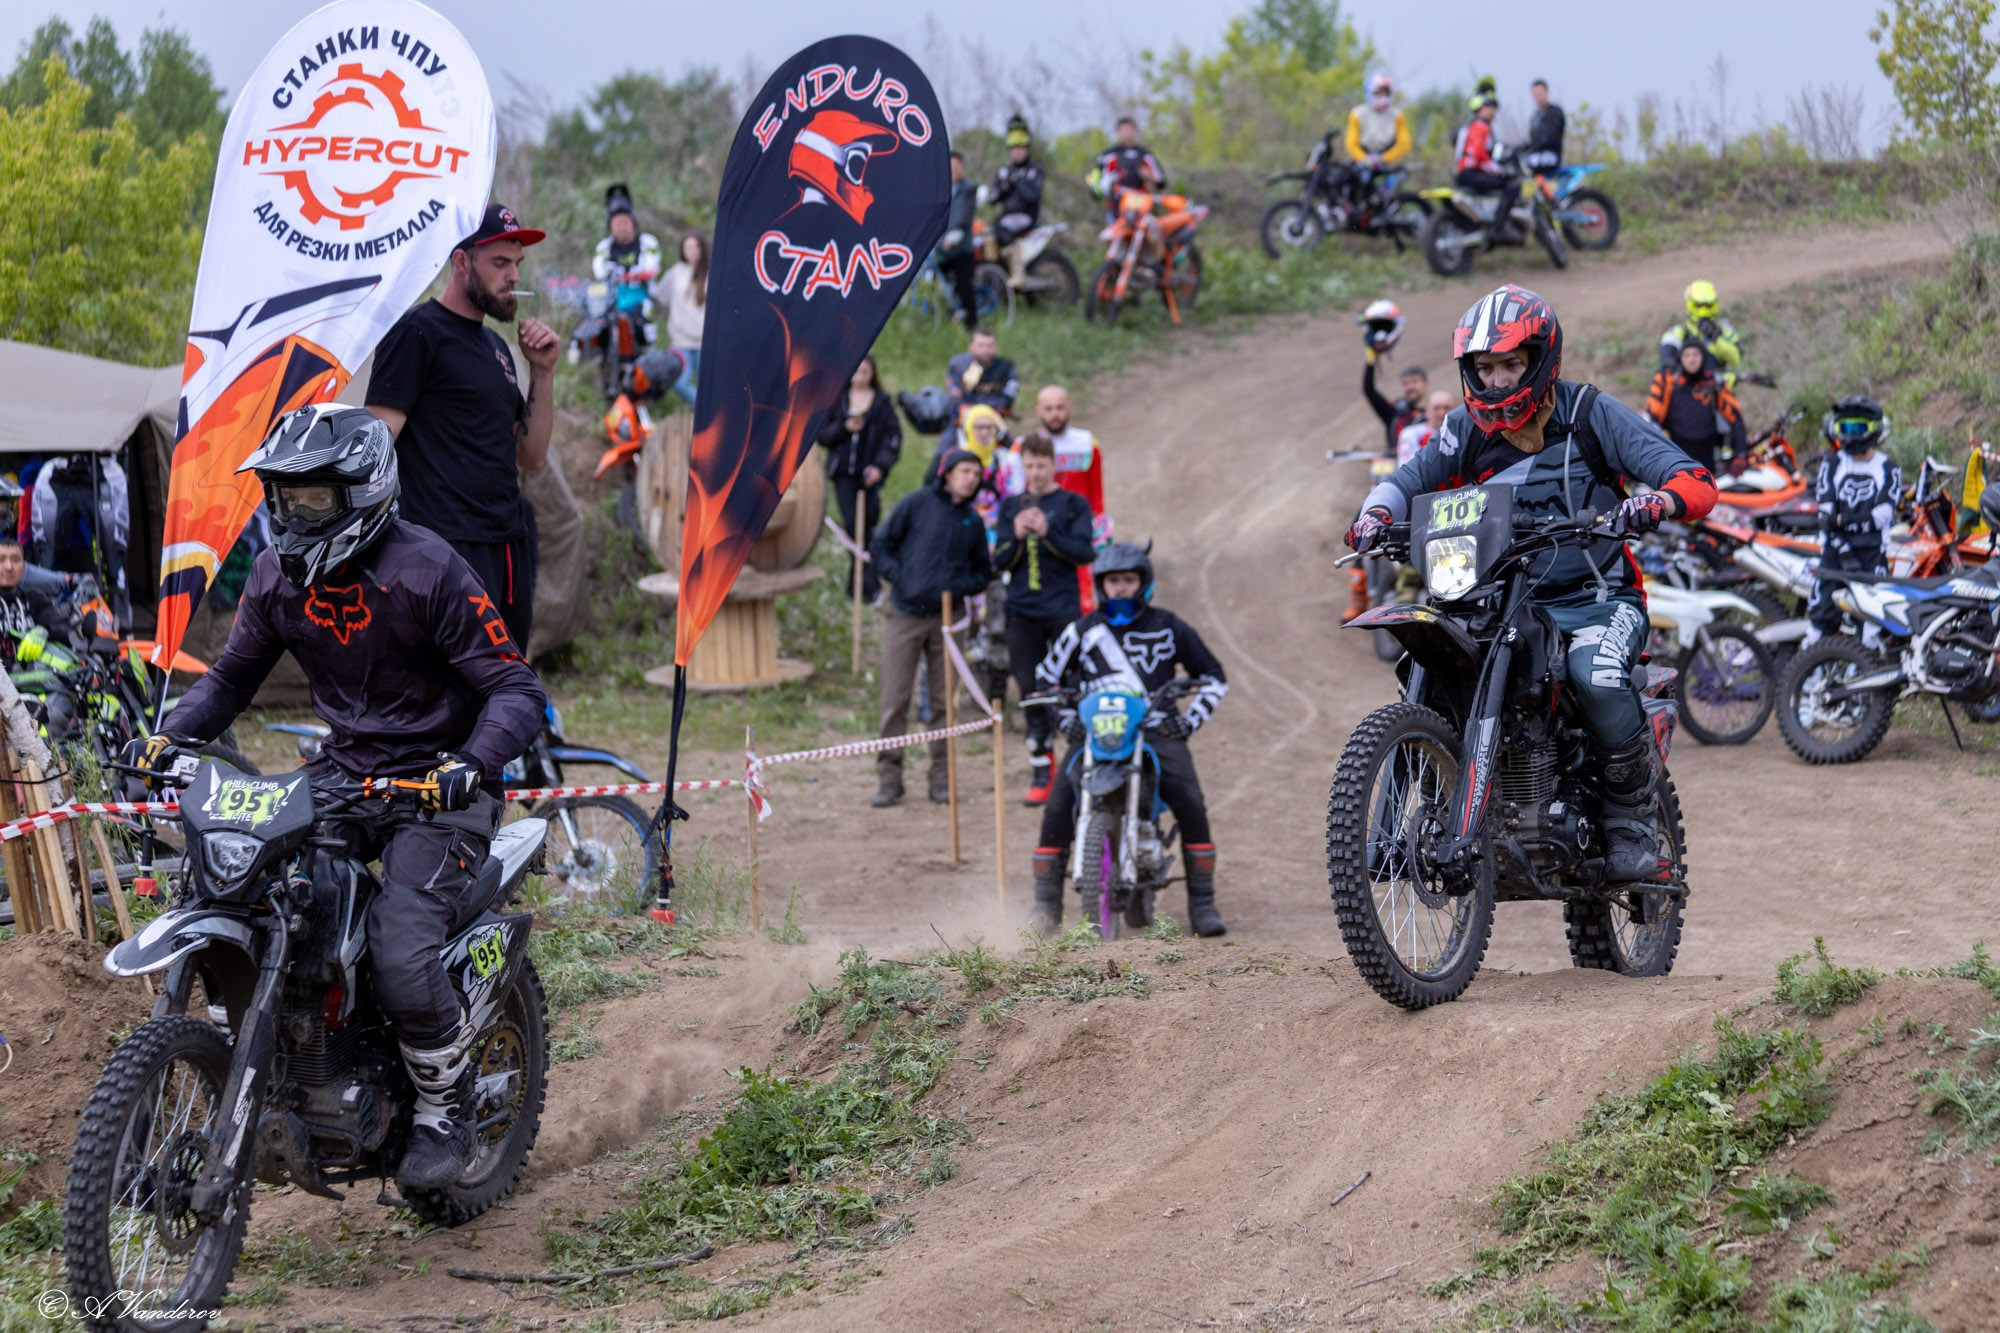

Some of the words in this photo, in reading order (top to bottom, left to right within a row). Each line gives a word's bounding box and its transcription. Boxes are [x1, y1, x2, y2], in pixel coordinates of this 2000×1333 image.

[273, 27, 379, 109] СТАНКИ
[391, 29, 447, 76] ЧПУ
[752, 63, 932, 153] ENDURO
[243, 136, 470, 173] HYPERCUT
[253, 201, 290, 240] ДЛЯ
[285, 229, 350, 261] РЕЗКИ
[354, 198, 446, 260] МЕТАЛЛА
[1437, 496, 1453, 506] HILL
[1455, 488, 1479, 501] CLIMB
[1444, 501, 1469, 521] 10
[228, 779, 247, 790] HILL
[249, 780, 279, 792] CLIMB
[228, 790, 263, 812] 95
[232, 811, 254, 823] LITE
[478, 941, 497, 969] 95
